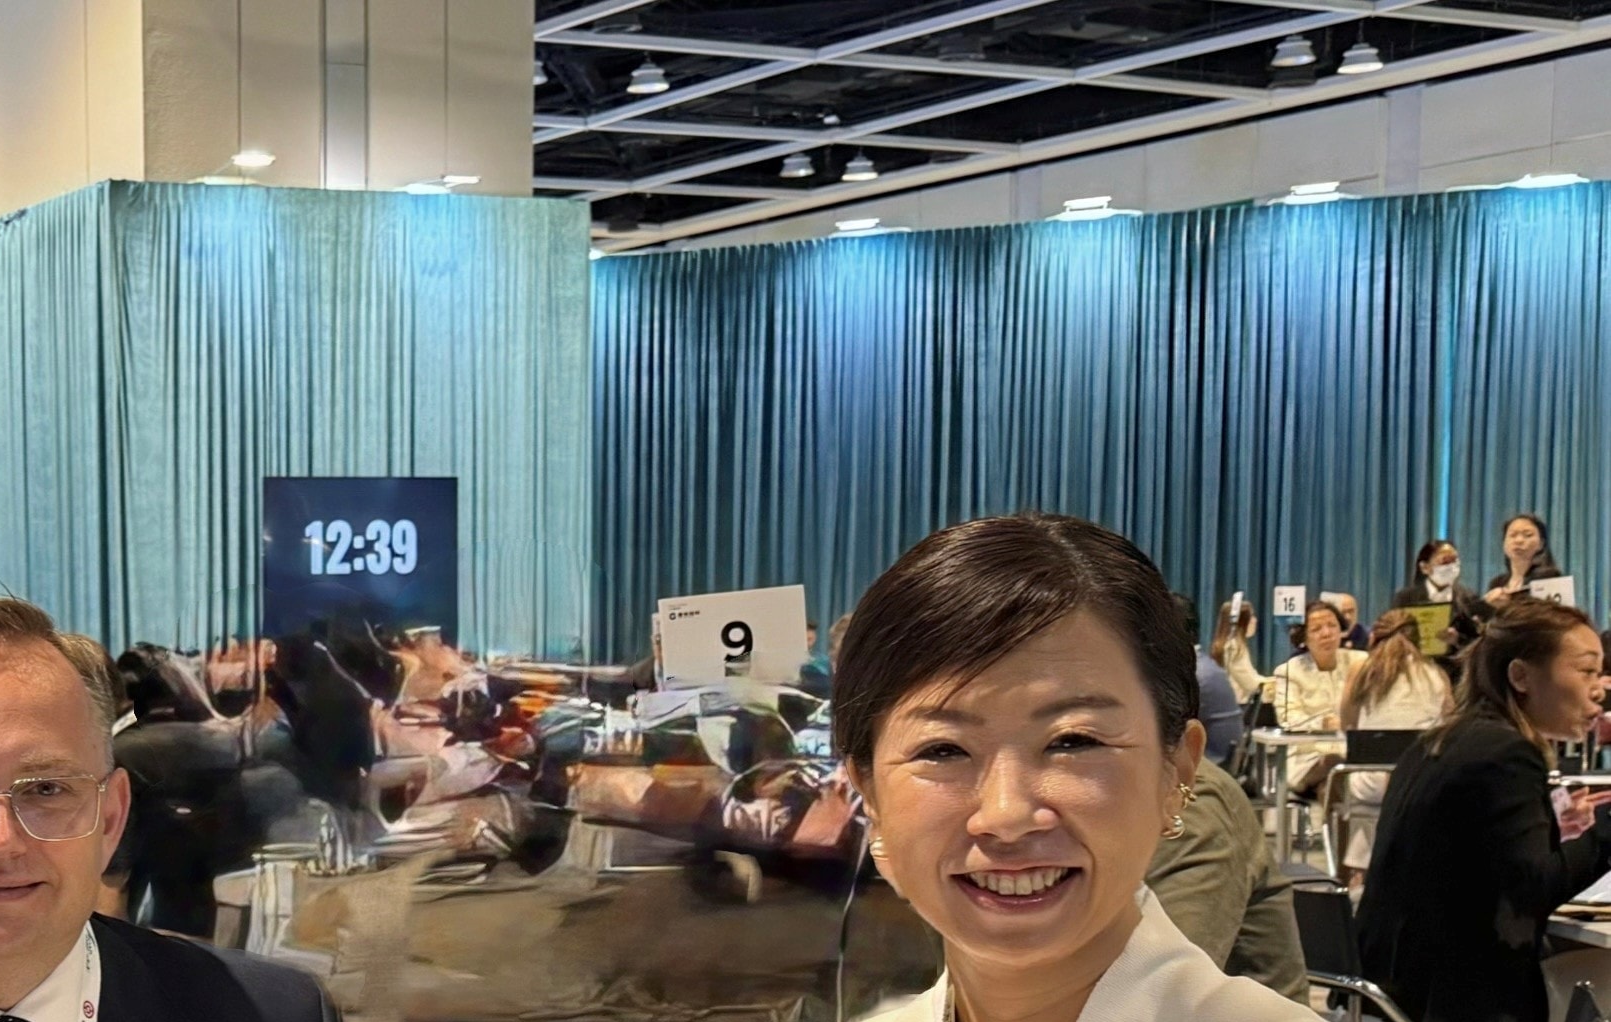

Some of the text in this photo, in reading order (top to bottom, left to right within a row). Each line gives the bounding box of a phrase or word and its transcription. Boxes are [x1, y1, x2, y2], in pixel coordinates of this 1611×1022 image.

[304, 519, 418, 575] 12:39
[1283, 597, 1296, 612] 16
[721, 620, 753, 663] 9
